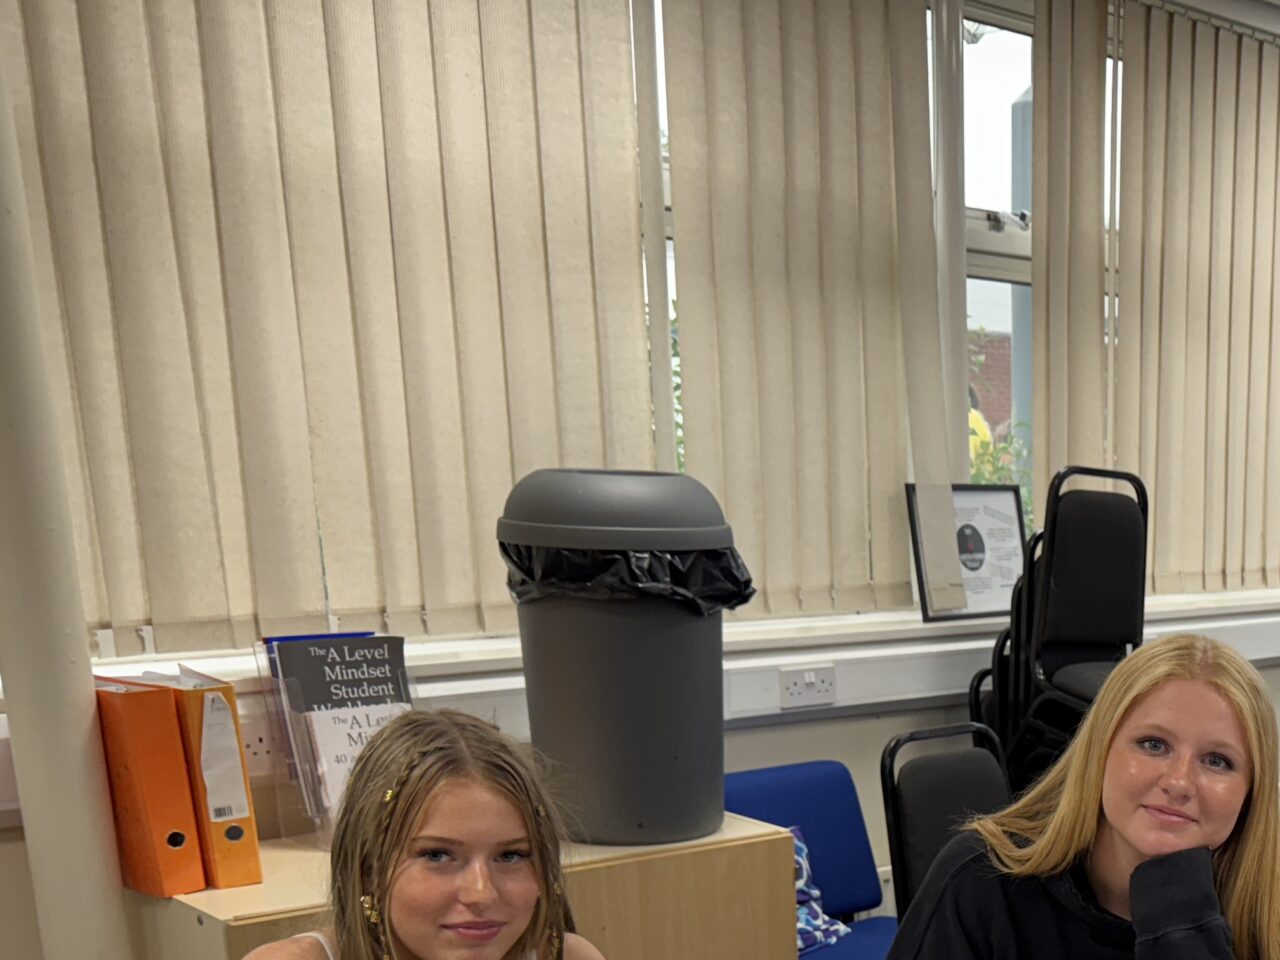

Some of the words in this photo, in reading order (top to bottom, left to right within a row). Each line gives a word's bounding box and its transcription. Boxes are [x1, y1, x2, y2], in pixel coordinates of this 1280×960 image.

[309, 647, 327, 656] The
[327, 647, 340, 662] A
[343, 644, 389, 661] Level
[324, 663, 391, 681] Mindset
[330, 682, 394, 699] Student
[350, 715, 362, 729] A
